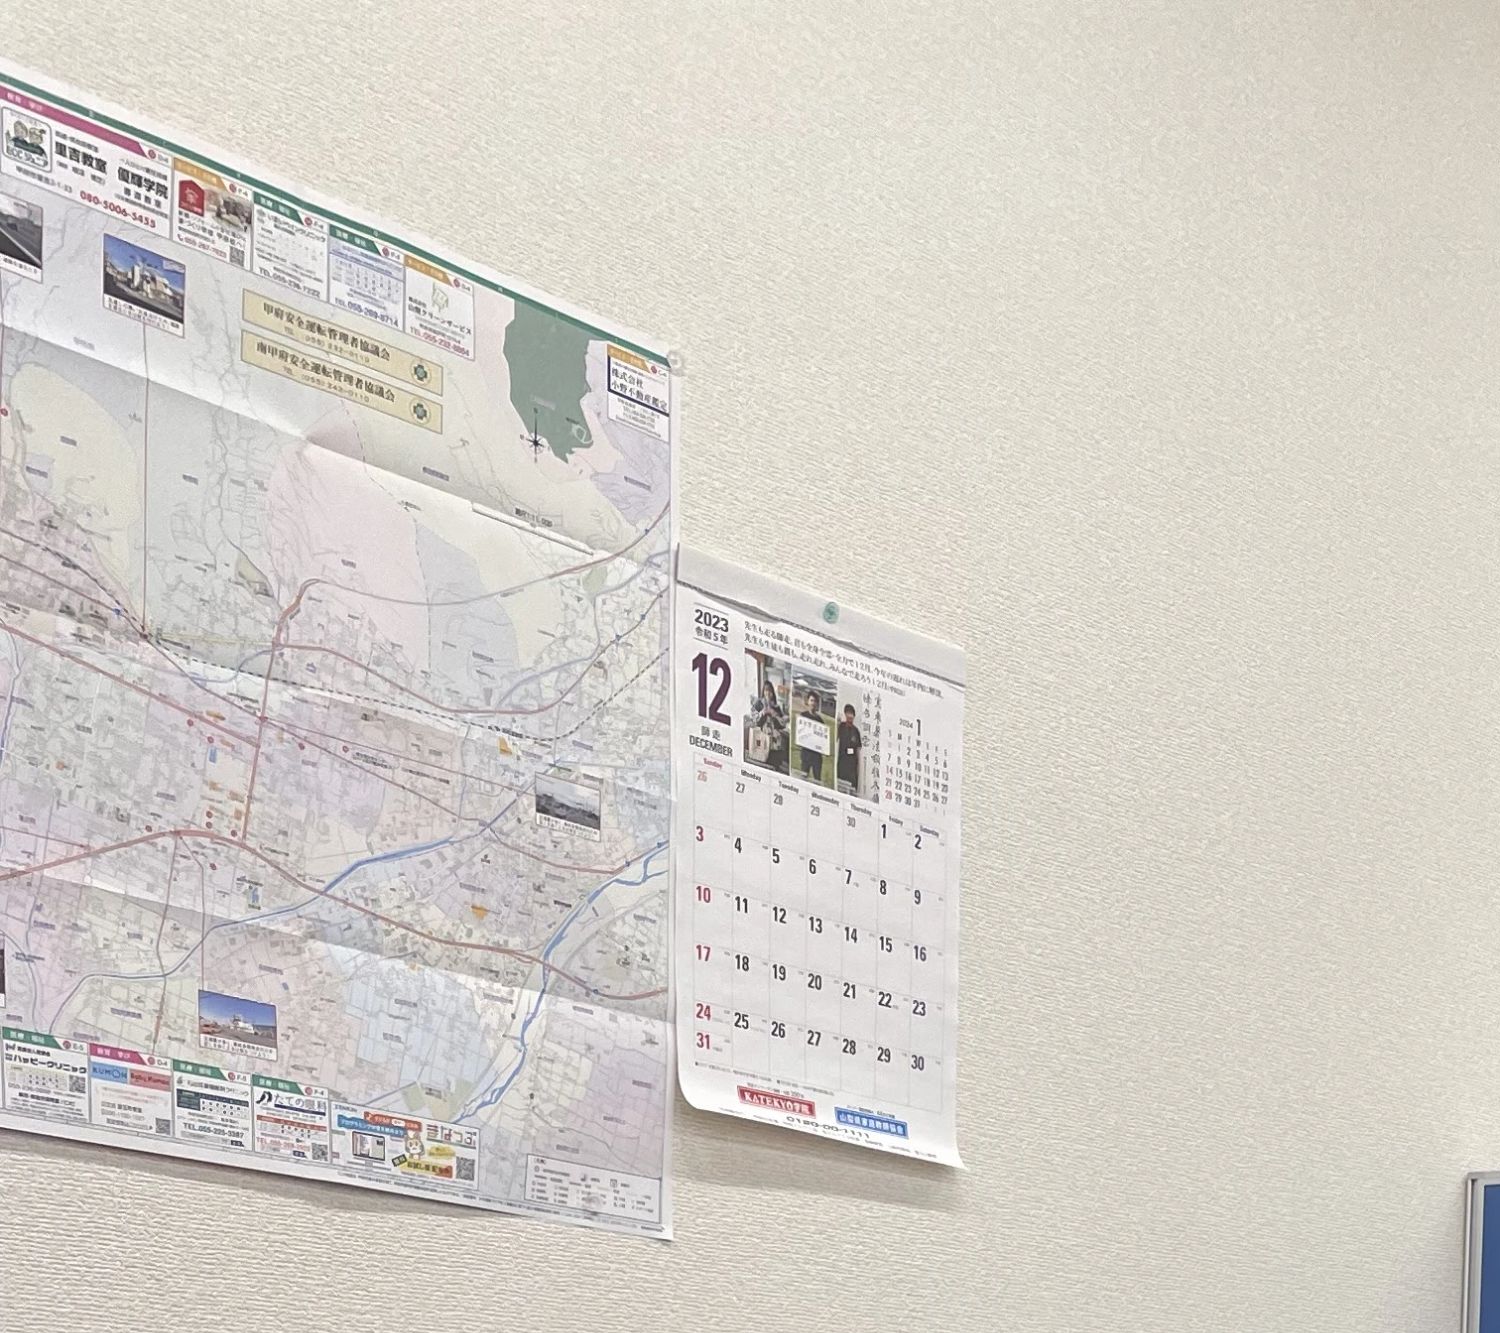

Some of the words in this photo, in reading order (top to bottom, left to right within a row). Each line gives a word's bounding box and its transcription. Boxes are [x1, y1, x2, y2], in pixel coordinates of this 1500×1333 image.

[263, 302, 390, 361] 甲府安全運転管理者協議会
[256, 341, 395, 403] 南甲府安全運転管理者協議会
[694, 609, 729, 633] 2023
[695, 626, 729, 645] 令和5年
[692, 652, 731, 726] 12
[689, 735, 733, 757] DECEMBER
[735, 782, 746, 794] 27
[810, 804, 820, 817] 29
[846, 815, 856, 828] 30
[881, 824, 887, 839] 1
[914, 834, 922, 850] 2
[778, 780, 799, 795] Tuesday
[696, 826, 704, 842] 3
[734, 837, 742, 853] 4
[772, 848, 780, 864] 5
[809, 859, 816, 874] 6
[845, 869, 852, 884] 7
[879, 880, 887, 895] 8
[914, 889, 921, 905] 9
[696, 886, 711, 903] 10
[735, 896, 748, 914] 11
[772, 906, 787, 924] 12
[808, 916, 823, 934] 13
[844, 925, 858, 944] 14
[879, 936, 893, 953] 15
[913, 945, 927, 962] 16
[696, 944, 711, 962] 17
[735, 954, 749, 972] 18
[772, 964, 787, 982] 19
[807, 973, 822, 991] 20
[842, 982, 857, 999] 21
[878, 991, 892, 1008] 22
[912, 1000, 926, 1017] 23
[696, 1002, 711, 1021] 24
[734, 1012, 749, 1030] 25
[771, 1021, 786, 1039] 26
[807, 1029, 822, 1047] 27
[842, 1038, 857, 1056] 28
[877, 1046, 891, 1064] 29
[911, 1054, 925, 1072] 30
[696, 1032, 711, 1050] 31
